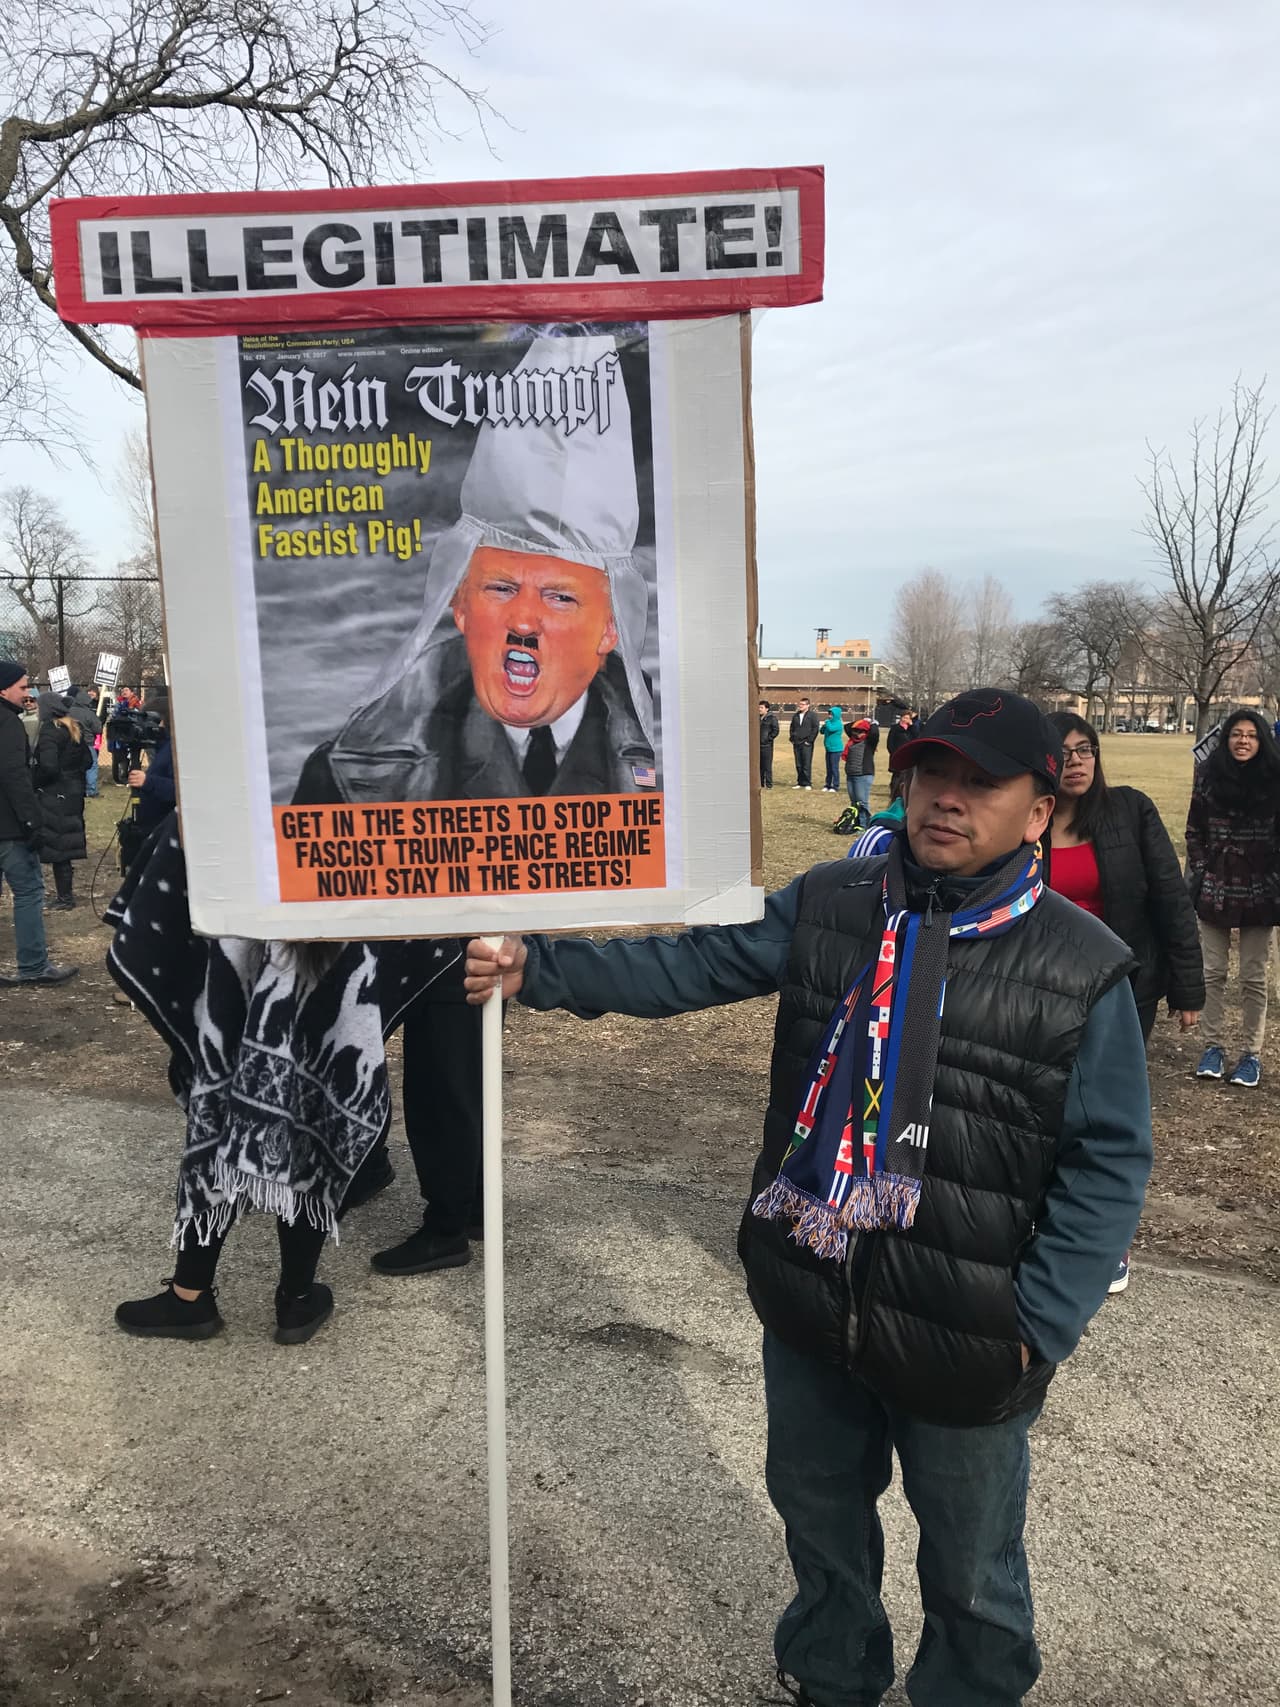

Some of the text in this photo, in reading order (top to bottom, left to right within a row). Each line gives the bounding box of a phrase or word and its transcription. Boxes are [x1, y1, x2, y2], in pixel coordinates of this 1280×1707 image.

[98, 205, 783, 294] ILLEGITIMATE!
[286, 340, 321, 348] Communist
[341, 337, 355, 345] USA
[245, 350, 620, 436] Mein Trumpf
[253, 432, 433, 476] A Thoroughly
[255, 479, 385, 516] American
[258, 518, 424, 560] Fascist Pig!
[99, 654, 119, 673] NO!
[281, 799, 662, 840] GET IN THE STREETS TO STOP THE
[296, 829, 651, 869] FASCIST TRUMP-PENCE REGIME
[317, 859, 632, 898] NOW! STAY IN THE STREETS!
